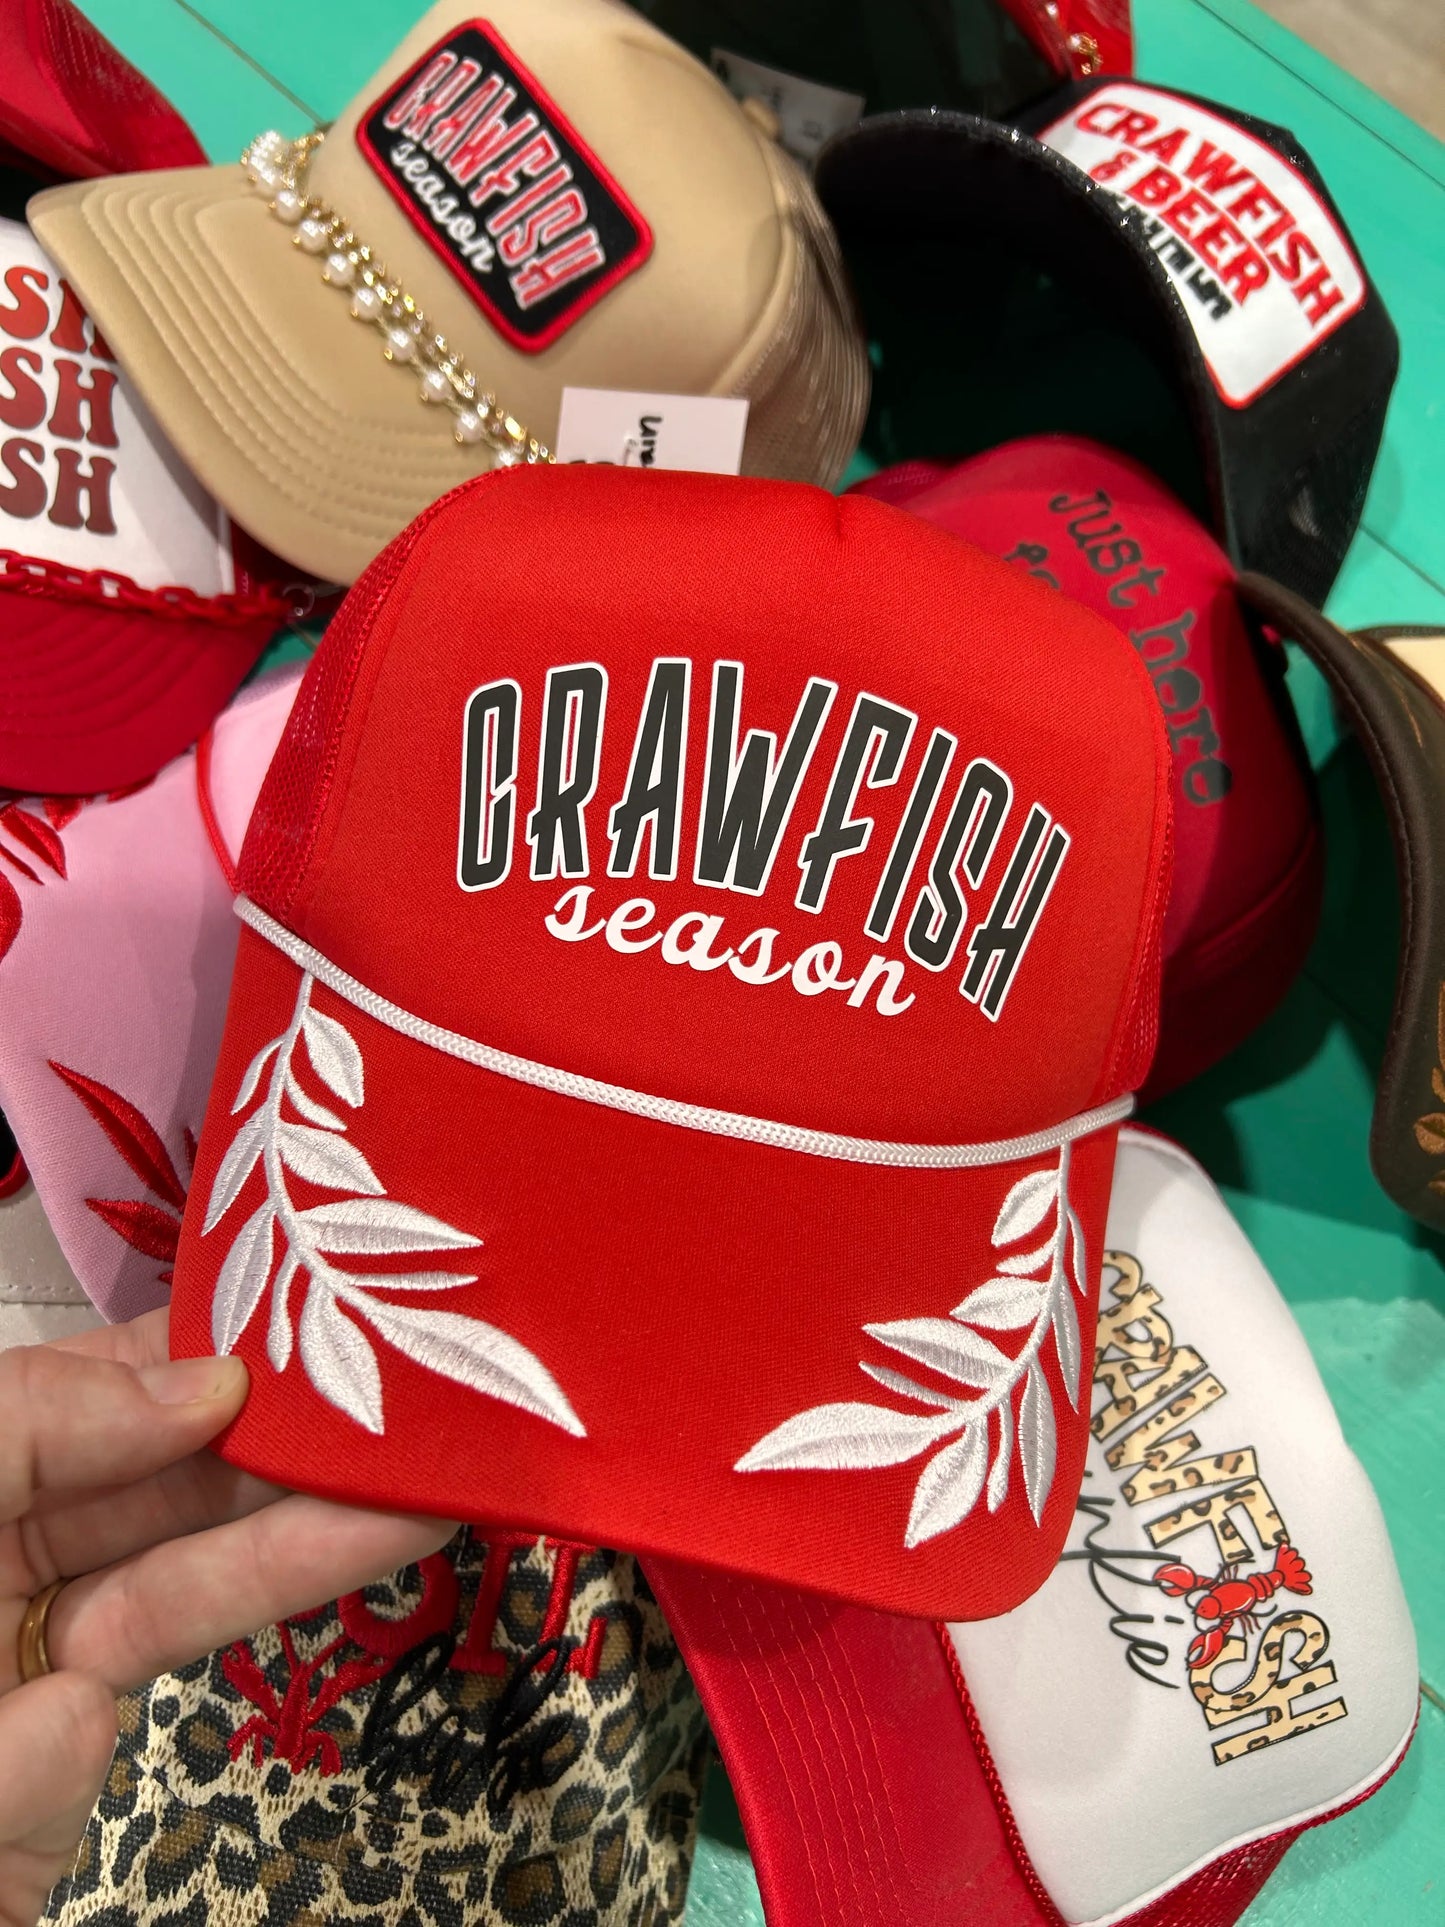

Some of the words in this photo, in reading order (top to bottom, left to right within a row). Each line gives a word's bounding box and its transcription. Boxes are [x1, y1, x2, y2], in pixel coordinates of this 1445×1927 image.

[383, 51, 606, 310] CRAWFISH
[391, 142, 497, 273] season
[1075, 103, 1345, 328] CRAWFISH
[1125, 165, 1270, 308] BEER
[1048, 489, 1166, 608] Just
[456, 657, 1071, 1021] CRAWFISH
[544, 885, 915, 1016] season
